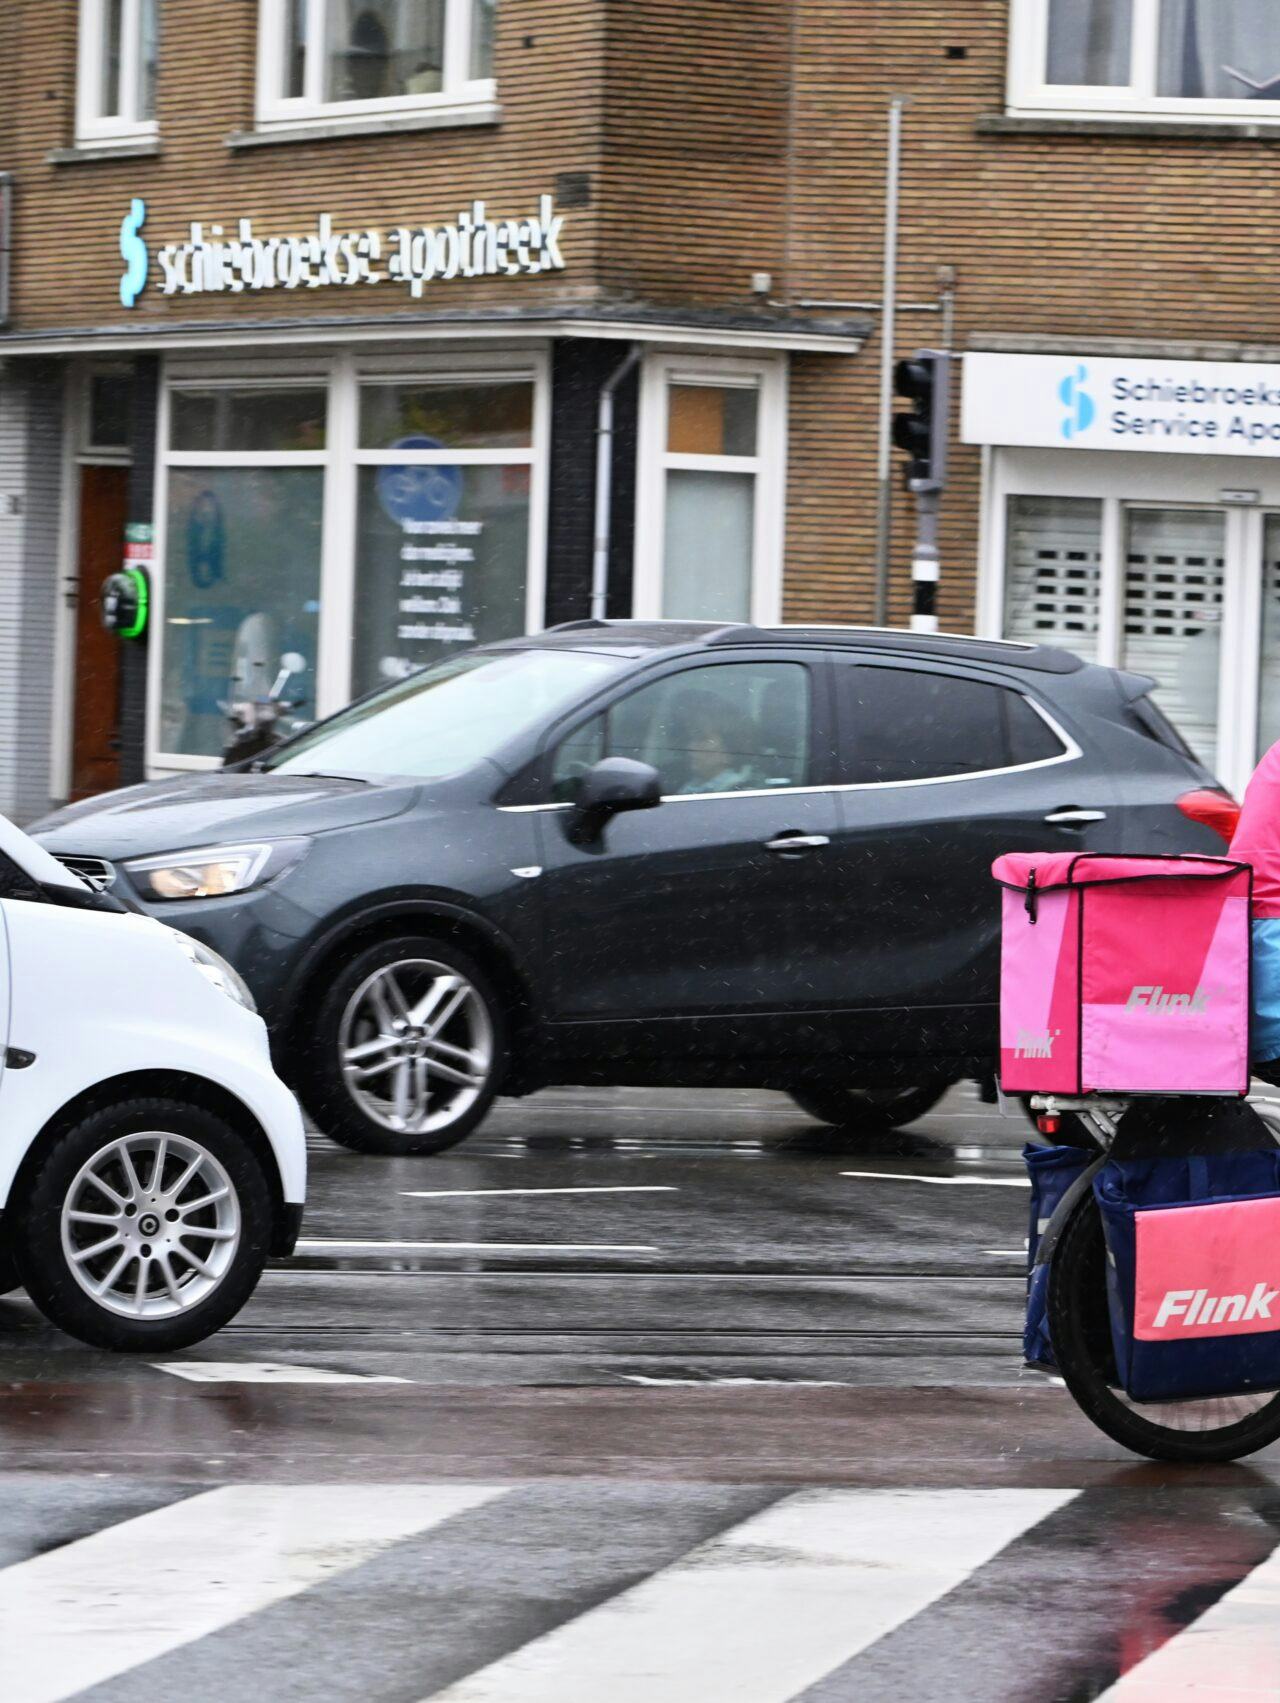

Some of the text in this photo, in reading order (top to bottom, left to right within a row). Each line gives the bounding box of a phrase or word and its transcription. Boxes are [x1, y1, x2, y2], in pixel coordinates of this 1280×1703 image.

[156, 194, 566, 298] schiebroekse apotheek
[1111, 410, 1219, 439] Service
[1123, 986, 1211, 1015] Flink
[1152, 1282, 1280, 1328] Flink
